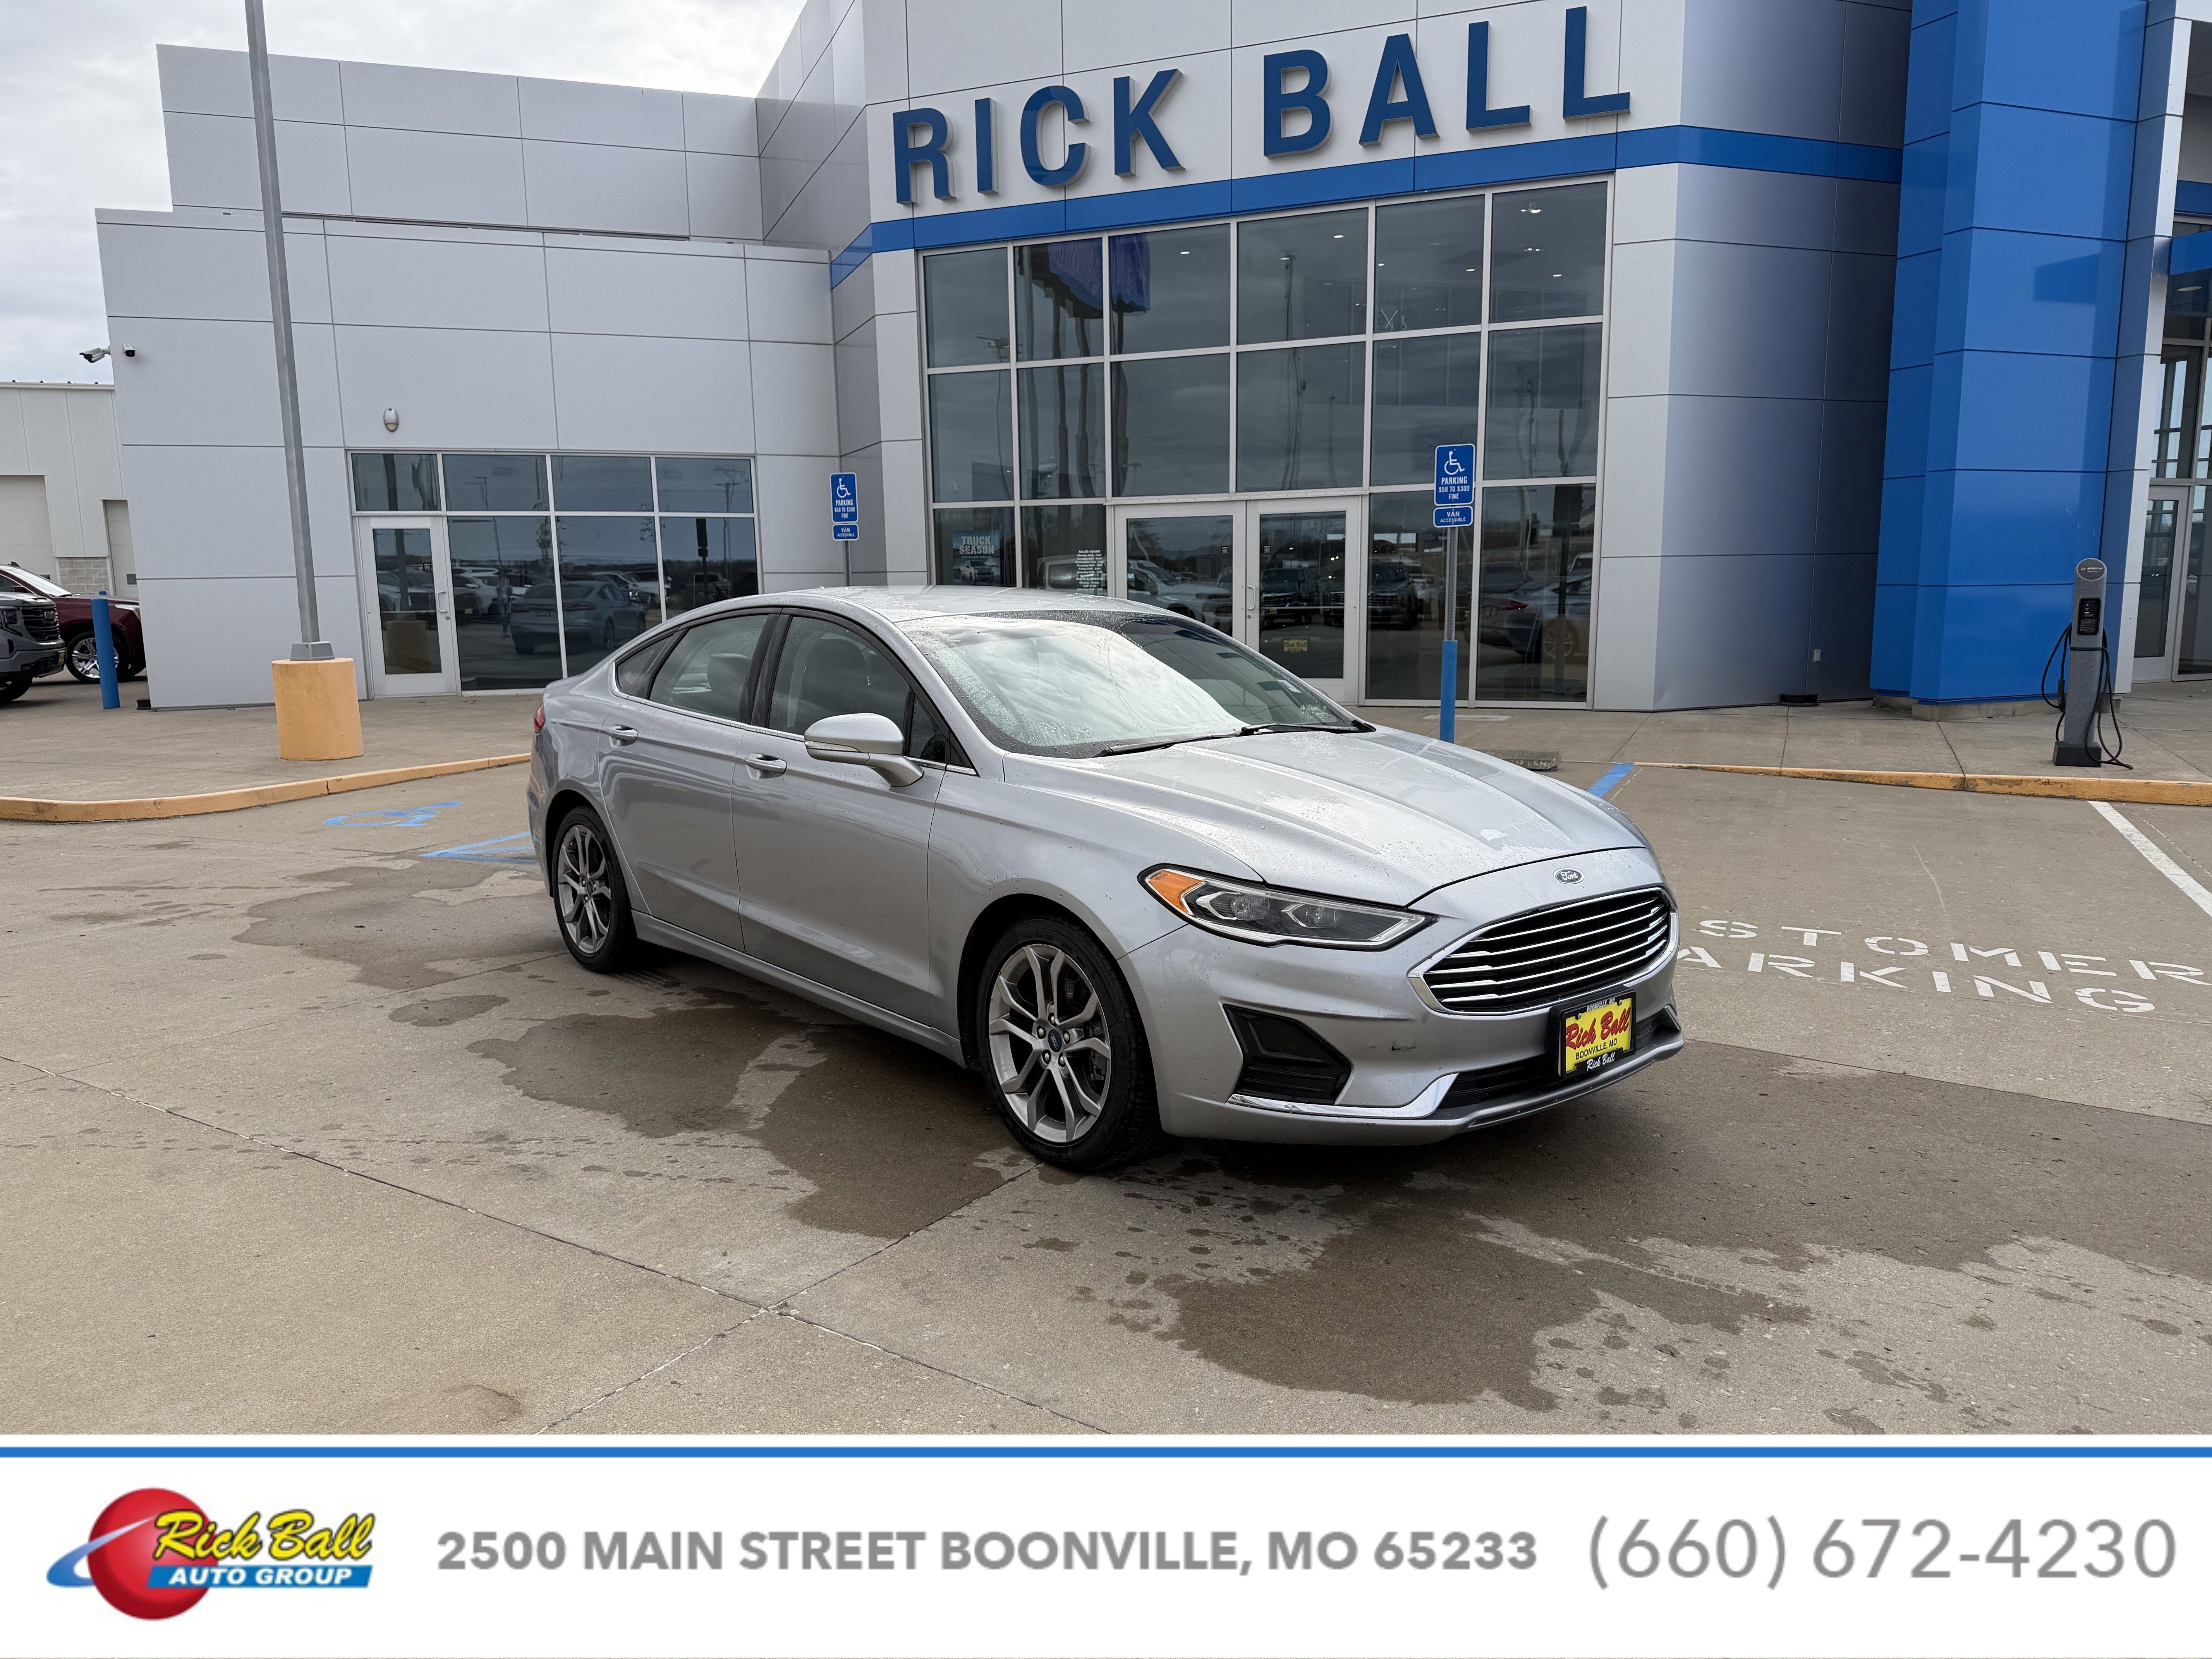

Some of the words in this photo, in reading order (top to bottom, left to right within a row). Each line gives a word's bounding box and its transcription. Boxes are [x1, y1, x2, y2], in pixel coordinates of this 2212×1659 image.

[892, 69, 1185, 206] RICK
[1263, 6, 1631, 159] BALL
[1441, 476, 1467, 485] PARKING
[959, 545, 994, 554] SEASON
[961, 536, 991, 545] TRUCK
[1560, 871, 1578, 881] Ford
[1698, 920, 2212, 985] STOMER
[1677, 946, 2155, 1012] ARKING
[1566, 1017, 1596, 1050] Rick
[1601, 1006, 1631, 1040] Ball
[1576, 1042, 1608, 1060] BOONVILLE,
[1609, 1038, 1617, 1047] MO
[1587, 1056, 1601, 1072] Rick
[1602, 1051, 1615, 1065] Ball
